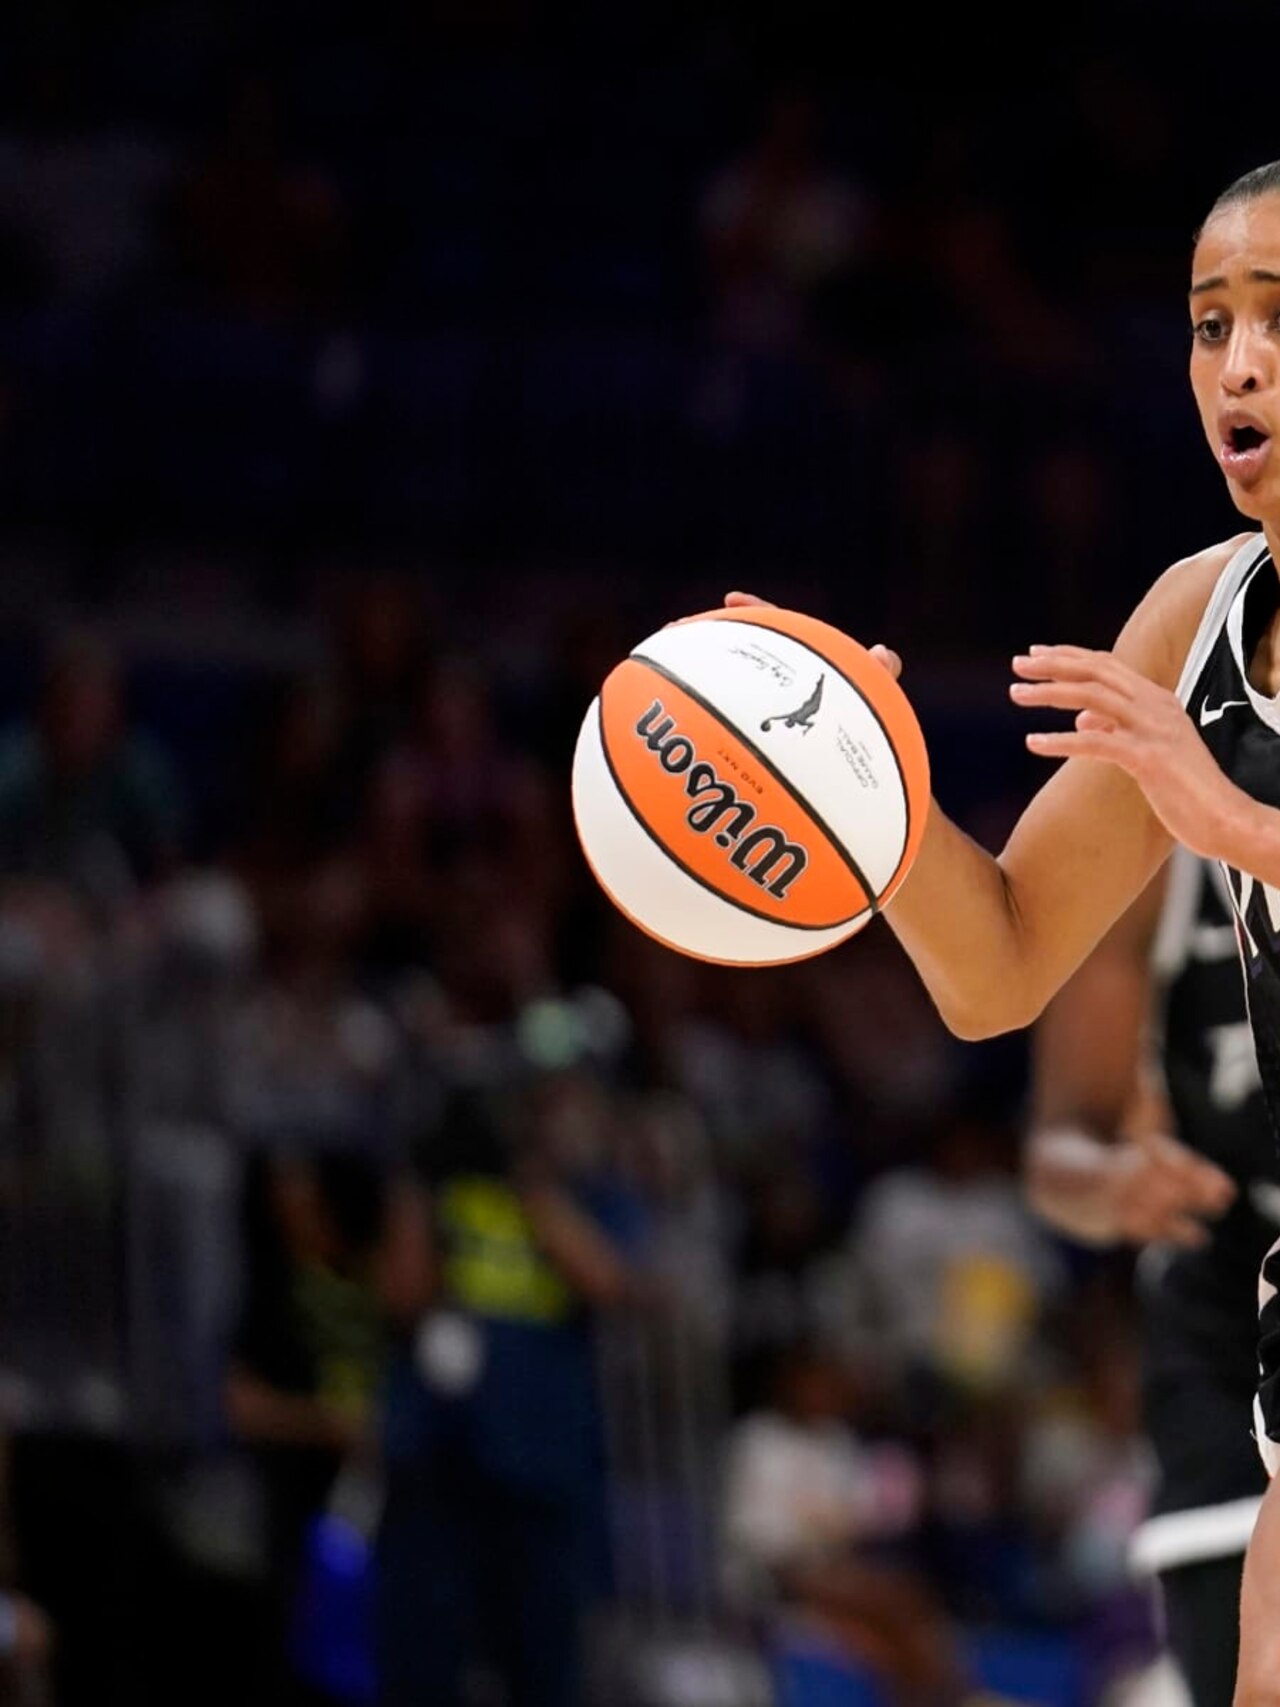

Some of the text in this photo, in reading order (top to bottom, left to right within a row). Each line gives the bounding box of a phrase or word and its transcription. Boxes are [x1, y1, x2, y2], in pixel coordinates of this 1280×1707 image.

[715, 746, 764, 795] EVO NXT
[837, 736, 869, 788] OFFICIAL
[857, 755, 878, 789] GAME
[634, 699, 809, 900] Wilson
